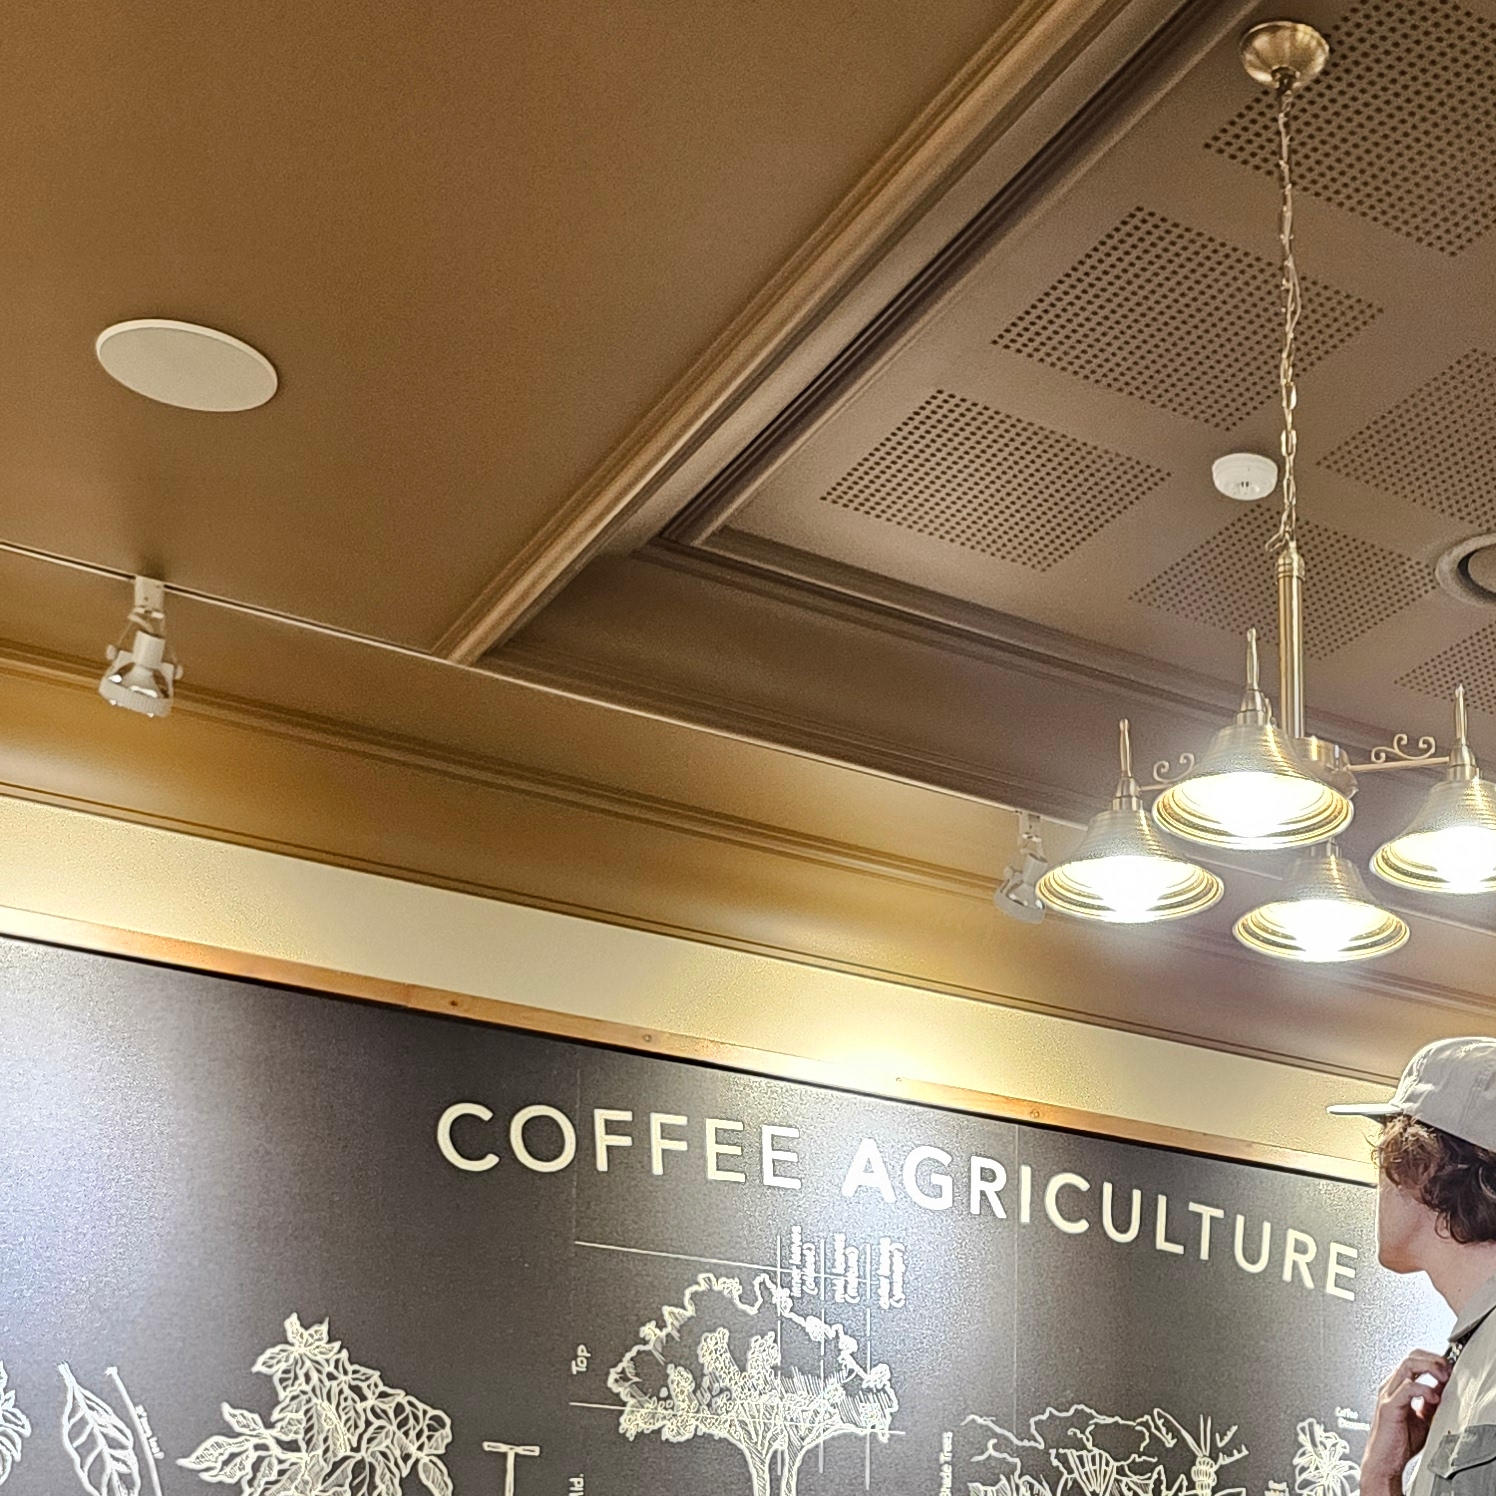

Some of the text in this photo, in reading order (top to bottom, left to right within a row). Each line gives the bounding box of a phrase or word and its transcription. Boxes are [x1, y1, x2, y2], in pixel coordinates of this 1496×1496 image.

[437, 1102, 802, 1190] COFFEE
[841, 1138, 1358, 1301] AGRICULTURE
[571, 1344, 592, 1375] Top
[938, 1431, 953, 1464] Trees
